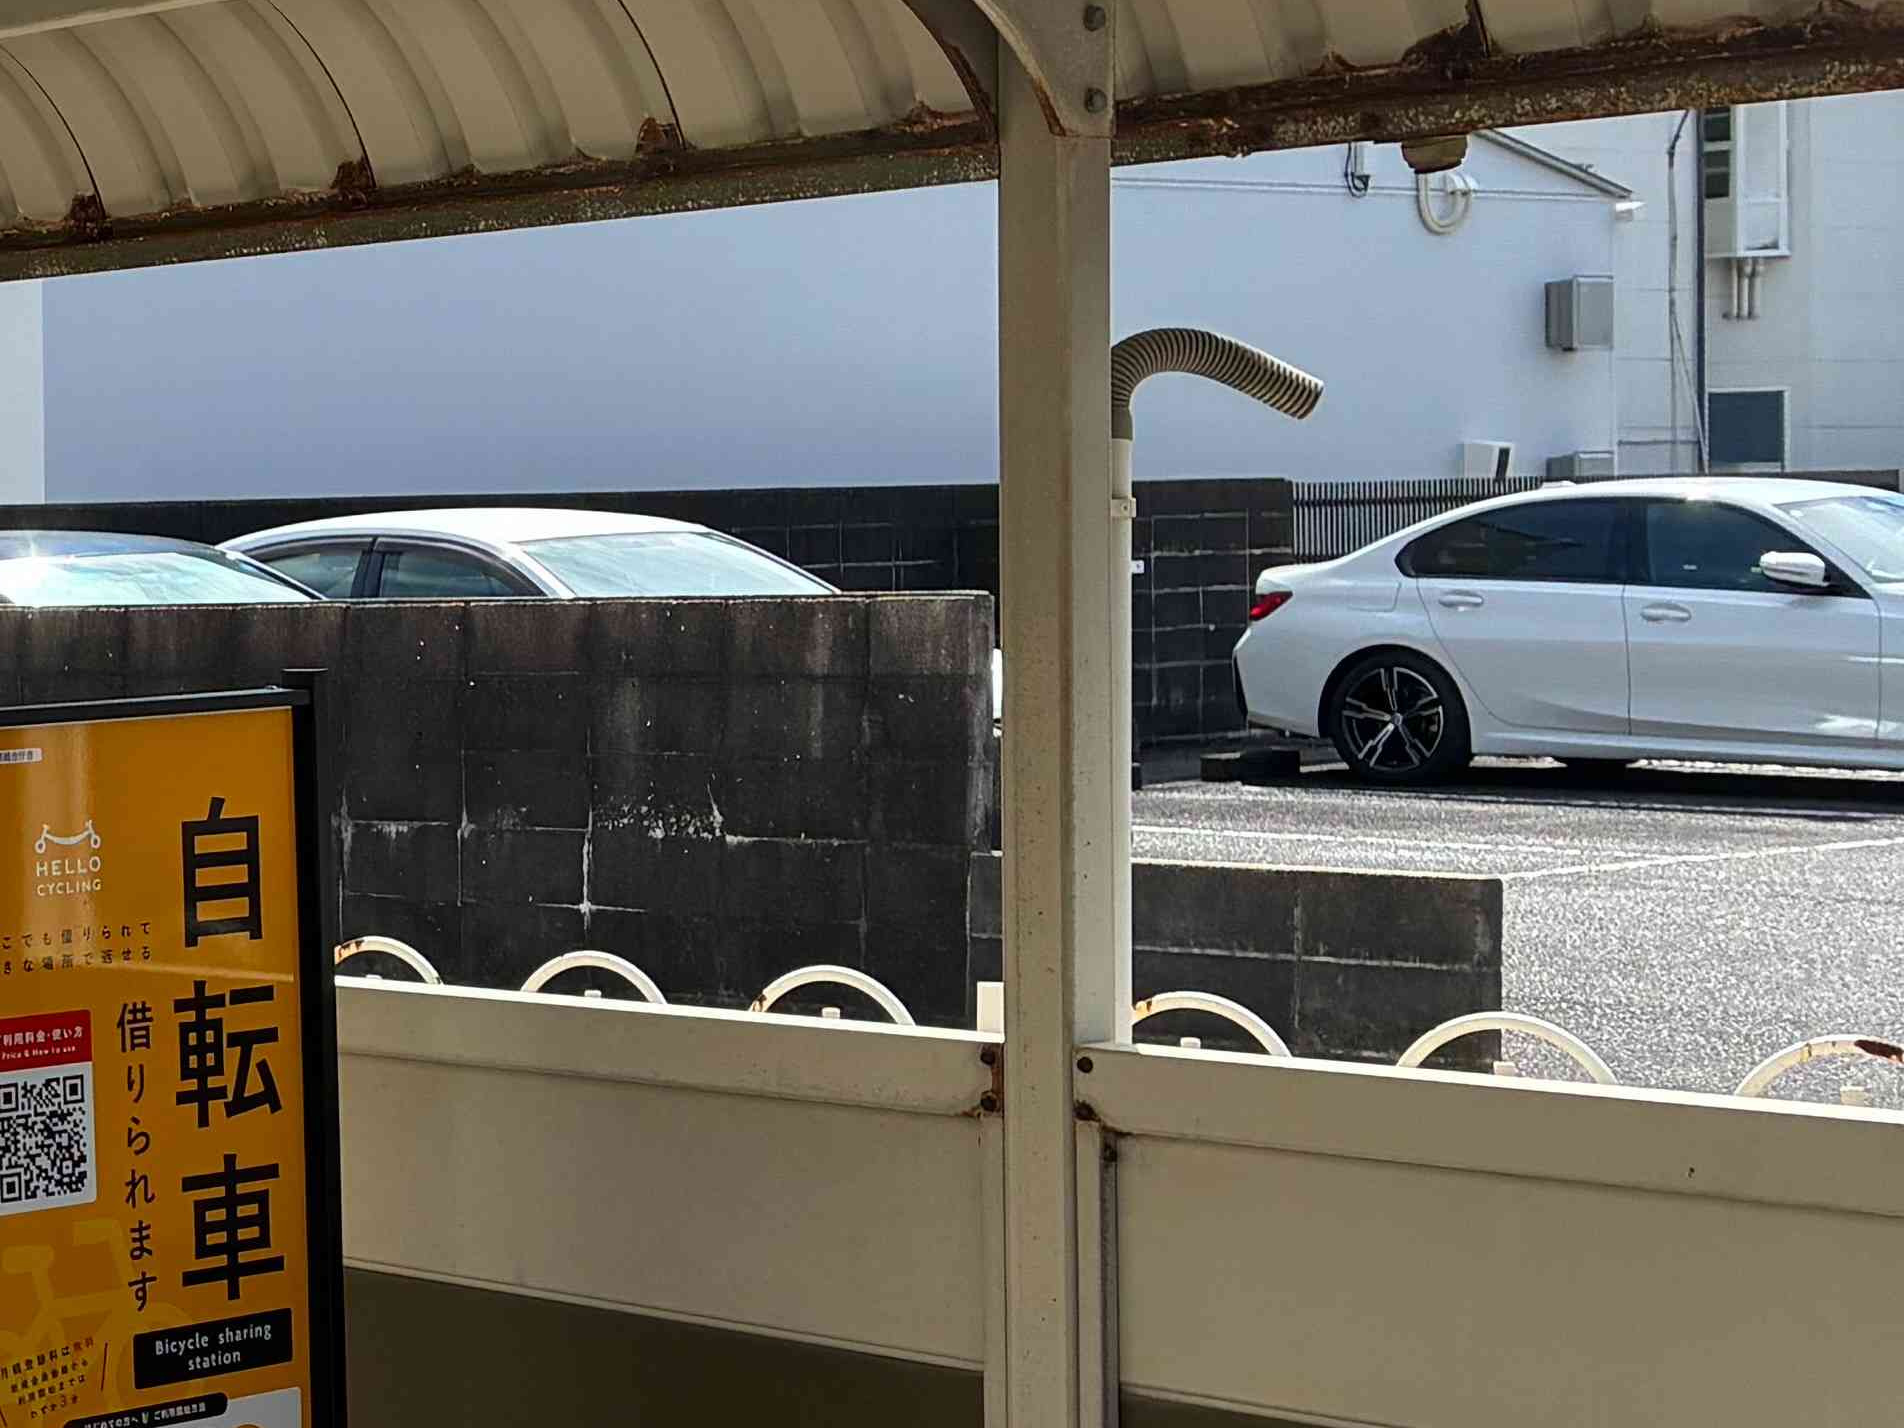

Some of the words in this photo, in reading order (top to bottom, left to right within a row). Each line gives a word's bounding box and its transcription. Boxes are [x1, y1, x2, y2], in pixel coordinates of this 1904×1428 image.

[35, 856, 102, 877] HELLO
[36, 879, 102, 897] CYCLING
[173, 796, 286, 1301] 自転車
[116, 1000, 158, 1312] 借りられます
[155, 1331, 209, 1357] Bicycle
[218, 1324, 272, 1346] sharing
[188, 1351, 241, 1371] station
